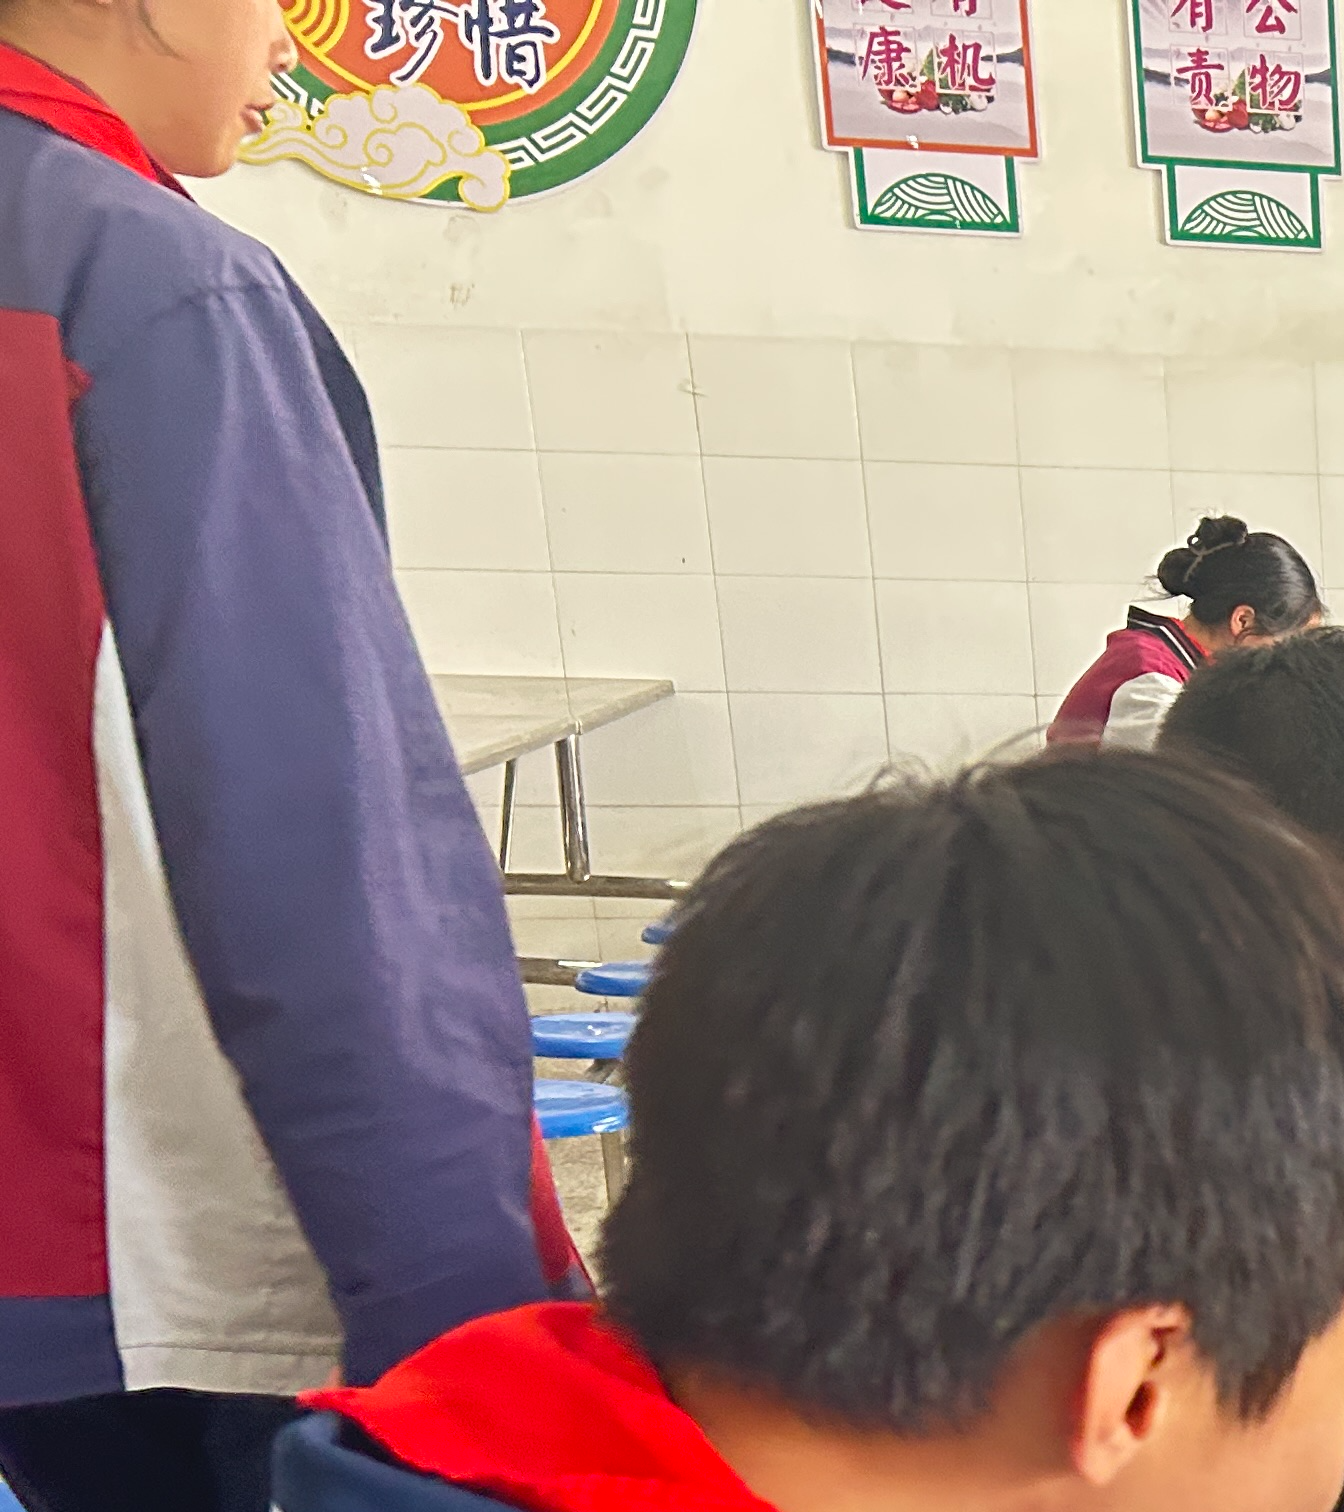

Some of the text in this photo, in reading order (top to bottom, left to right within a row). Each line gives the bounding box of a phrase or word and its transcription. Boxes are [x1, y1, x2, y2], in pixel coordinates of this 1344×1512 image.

[368, 0, 557, 90] 珍惜
[860, 0, 913, 87] 康
[936, 0, 996, 88] 机
[1246, 0, 1301, 107] 公物
